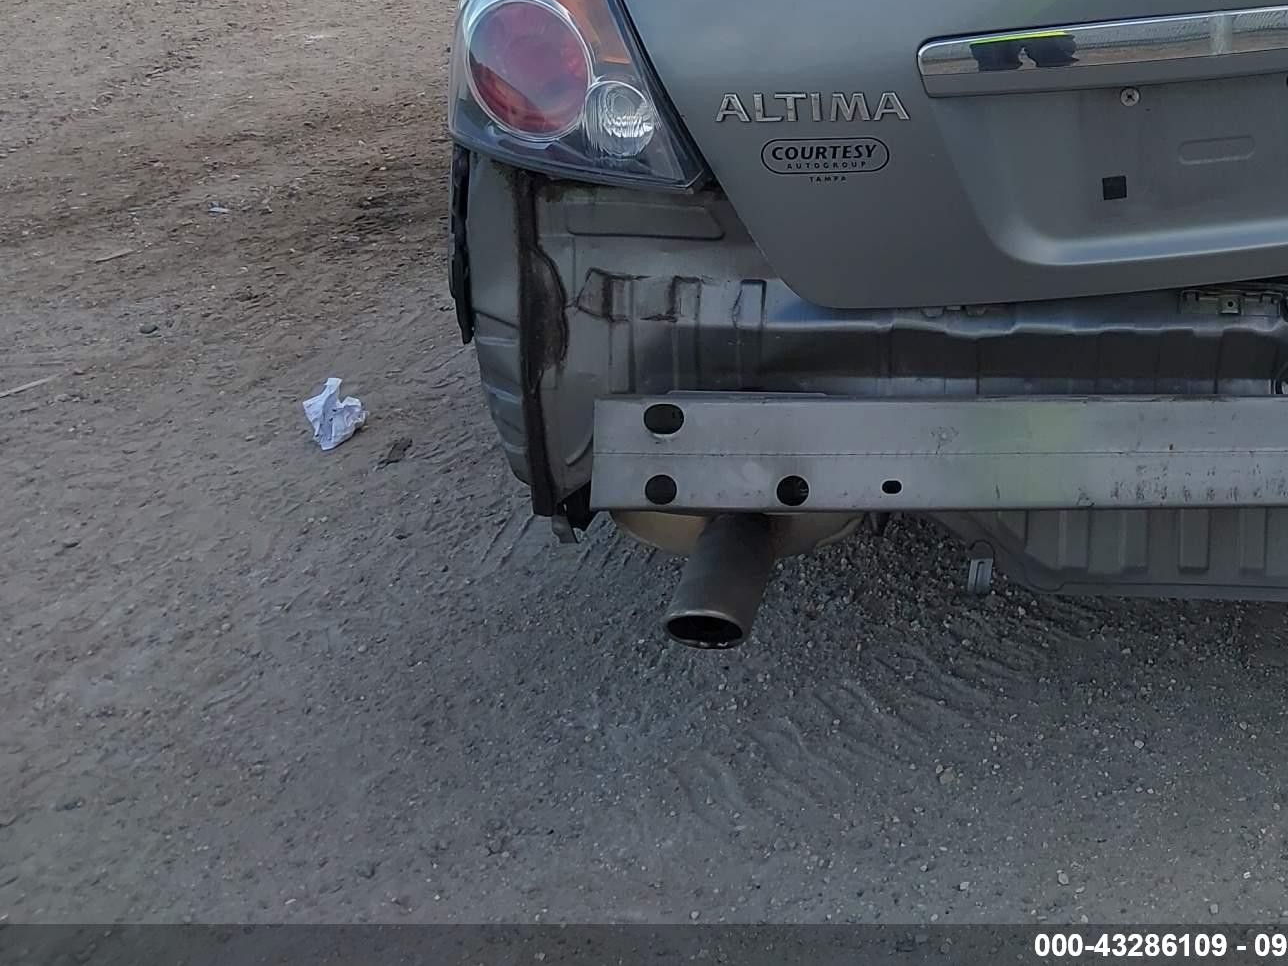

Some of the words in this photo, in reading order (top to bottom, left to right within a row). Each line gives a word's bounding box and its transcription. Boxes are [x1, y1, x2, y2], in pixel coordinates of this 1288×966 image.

[716, 92, 911, 122] ALTIMA
[771, 144, 878, 161] COURTESY
[786, 161, 867, 170] AUTOGROUP
